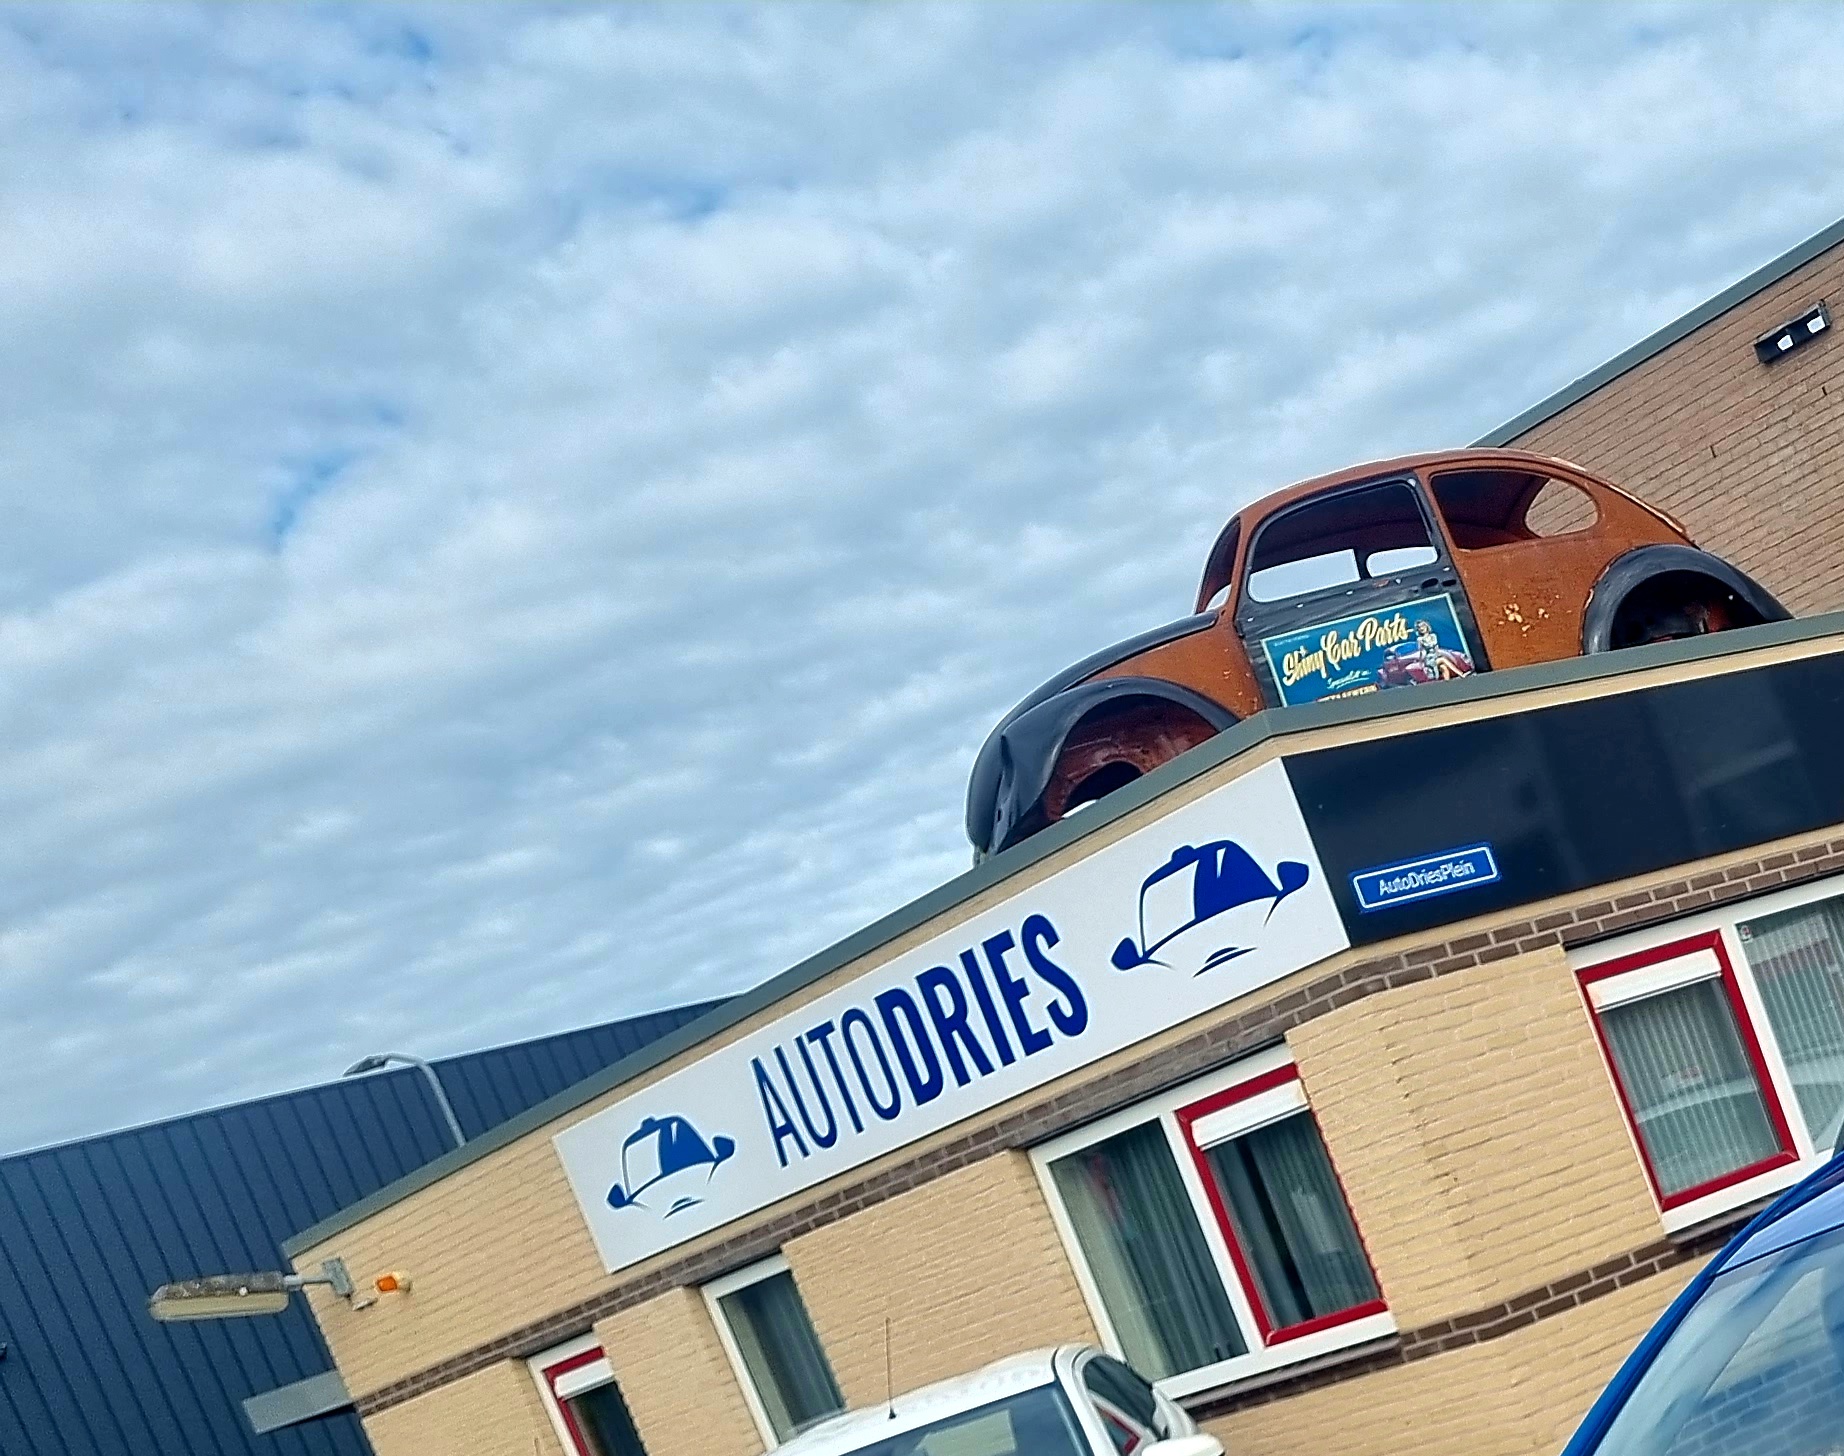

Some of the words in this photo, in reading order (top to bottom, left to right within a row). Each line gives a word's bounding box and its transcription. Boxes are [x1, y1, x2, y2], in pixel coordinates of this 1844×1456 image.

[1282, 645, 1327, 686] Shiny
[1320, 630, 1361, 671] Car
[1356, 612, 1413, 652] Parts
[1379, 860, 1476, 896] AutoDriesPlein
[750, 912, 1089, 1168] AUTODRIES
